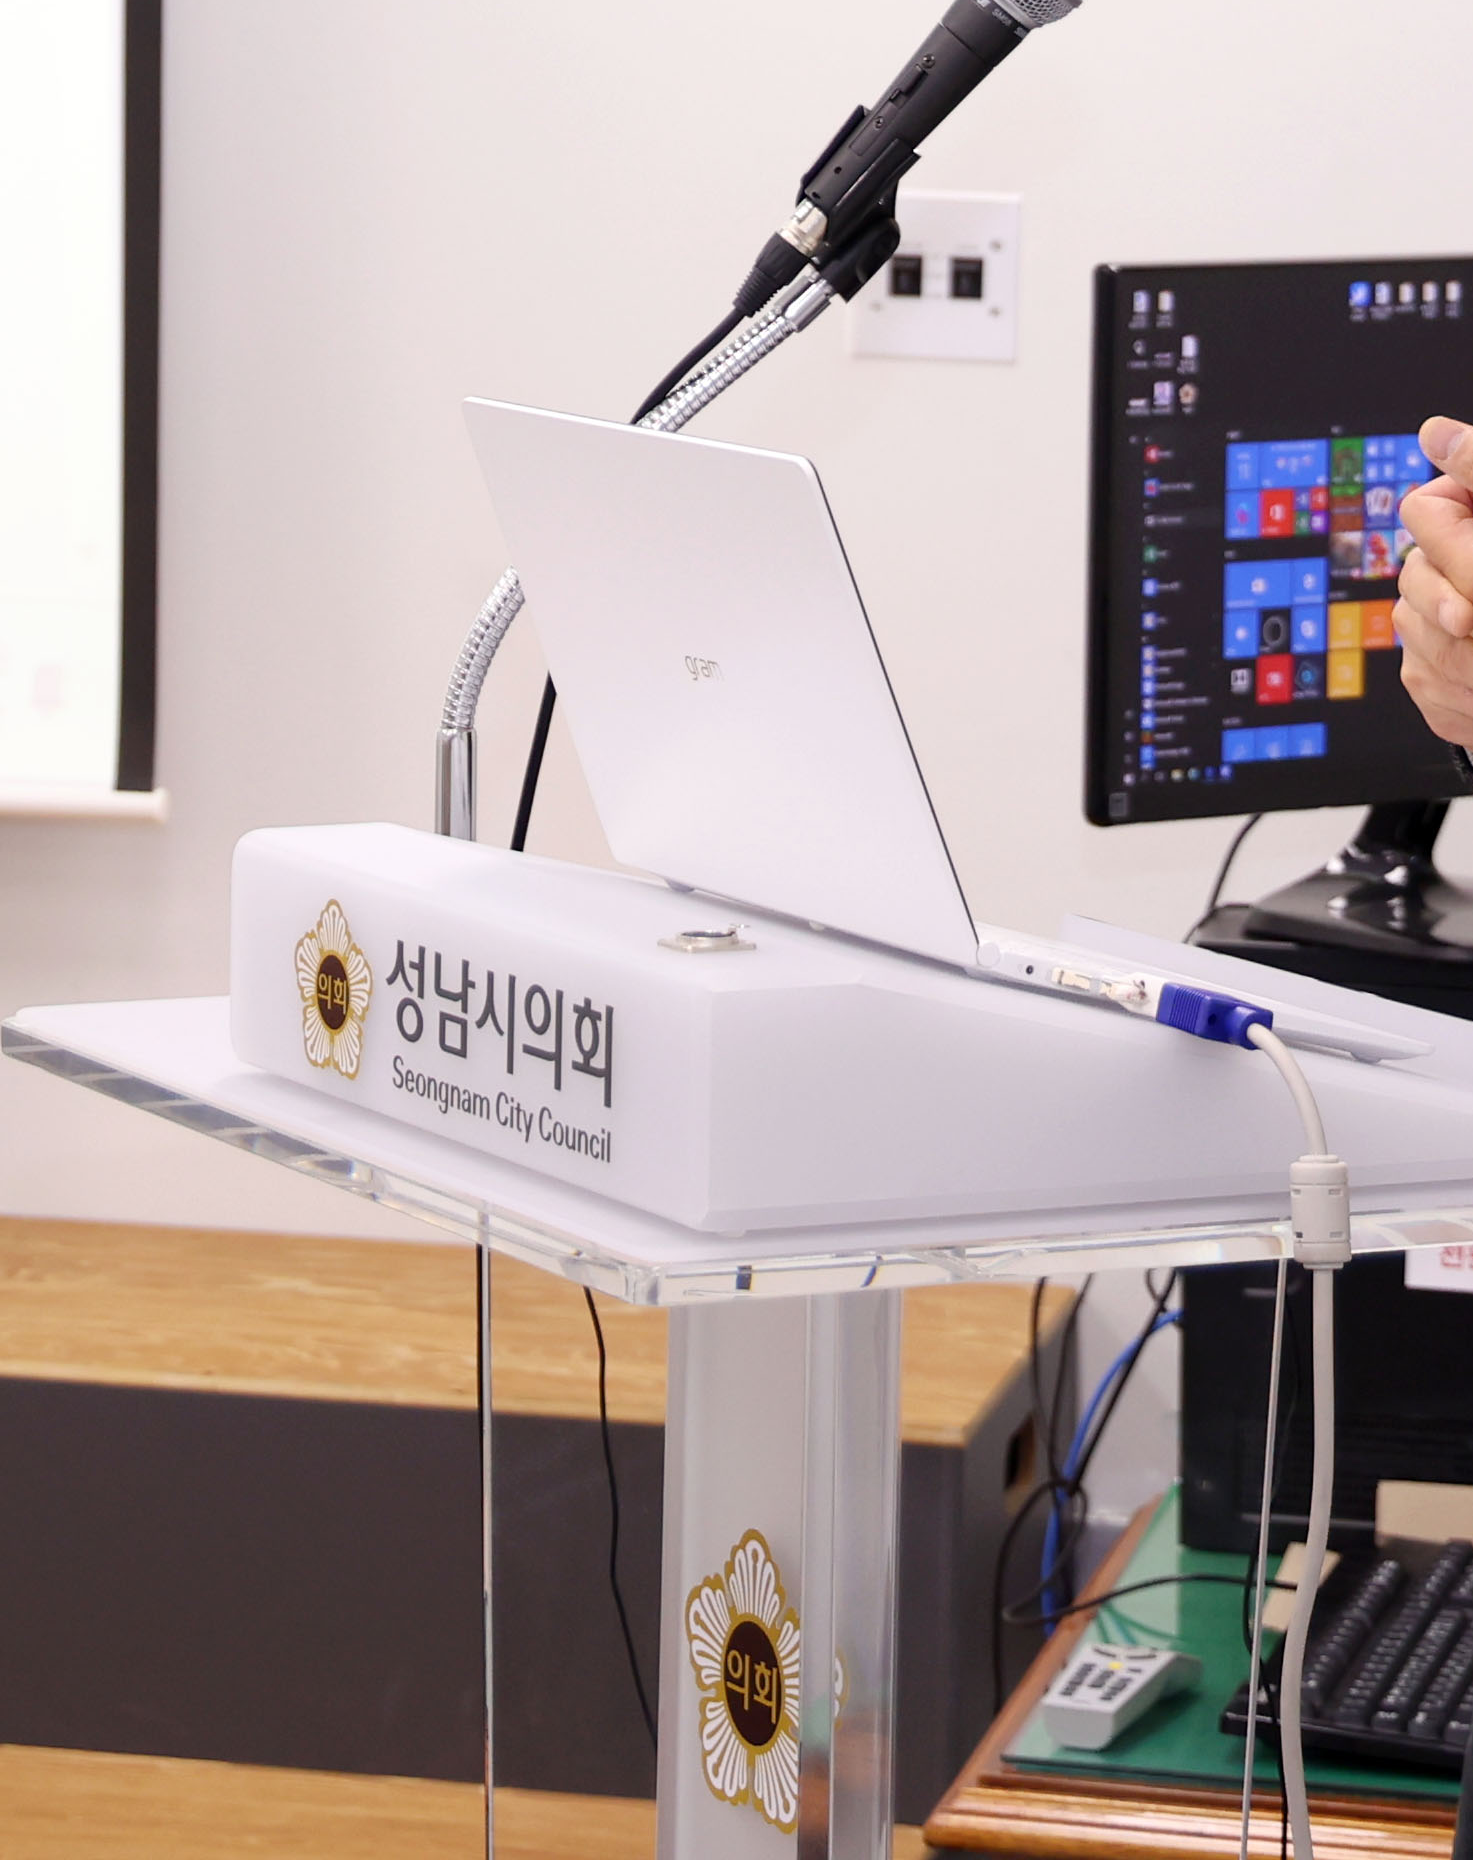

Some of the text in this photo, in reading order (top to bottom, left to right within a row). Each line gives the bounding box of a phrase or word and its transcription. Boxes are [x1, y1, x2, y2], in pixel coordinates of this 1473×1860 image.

[316, 970, 349, 1016] 의회
[386, 939, 615, 1108] 성남시의회
[390, 1054, 613, 1164] Seongnam City Council
[725, 1648, 778, 1725] 의회
